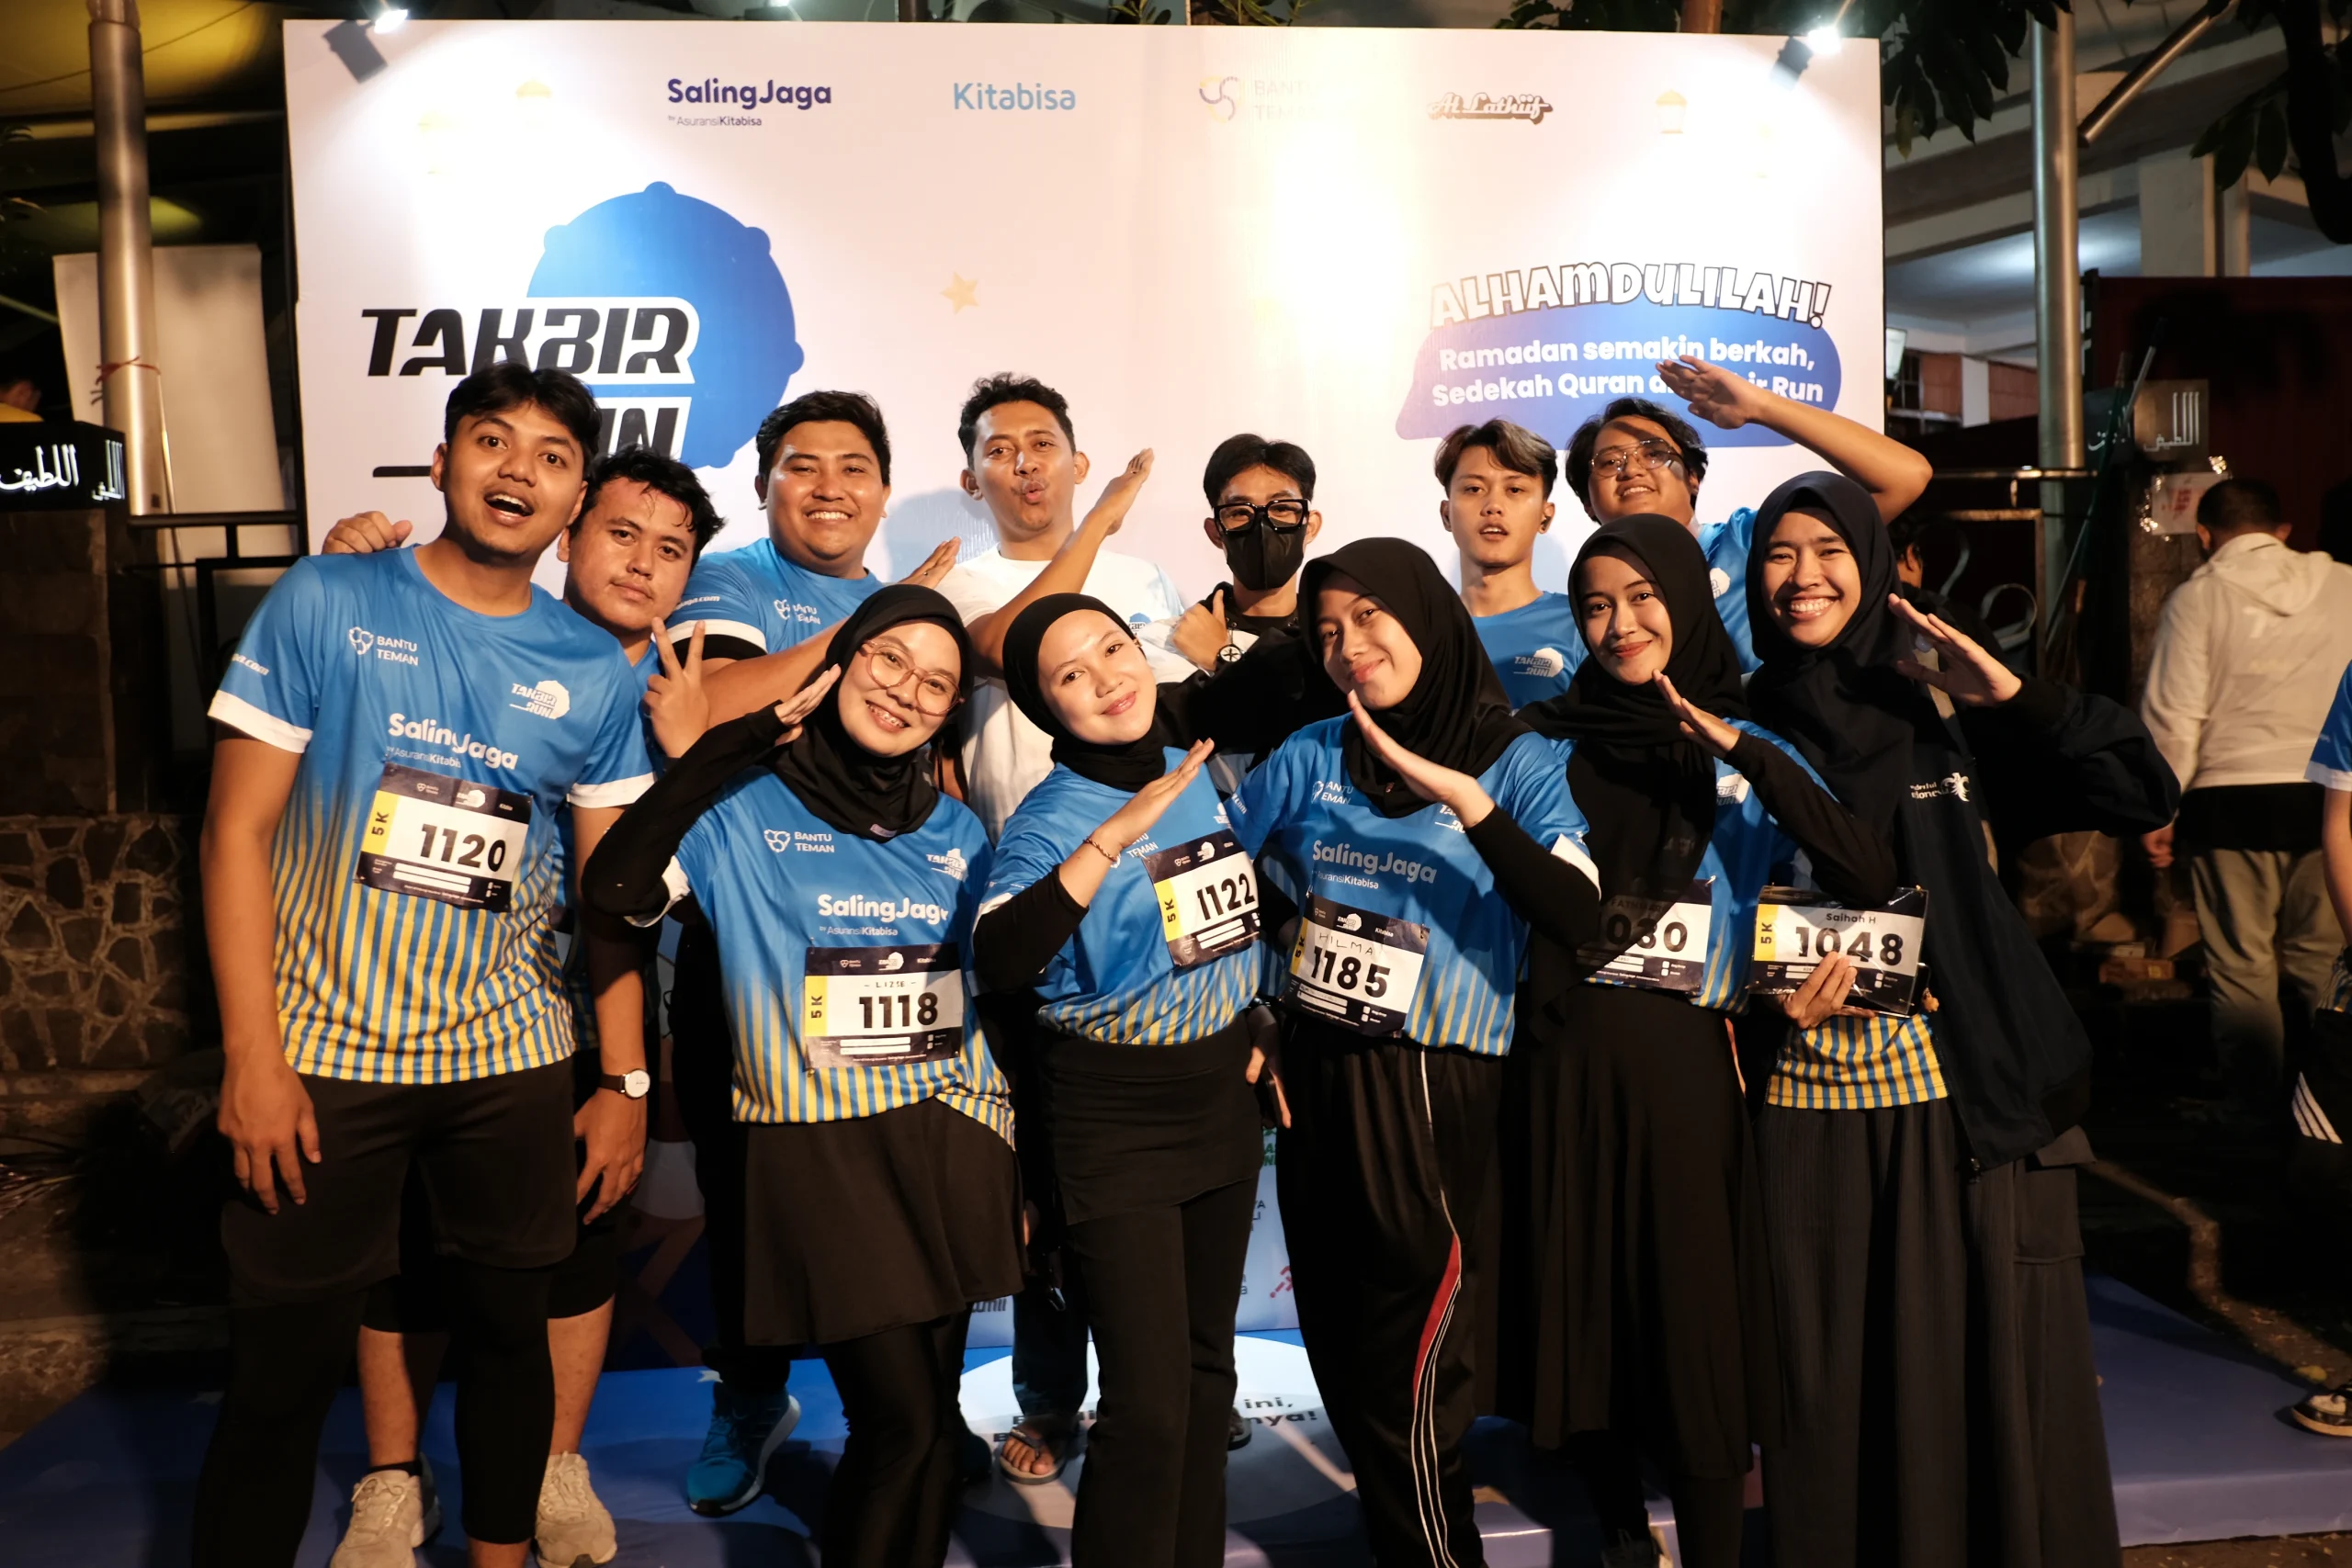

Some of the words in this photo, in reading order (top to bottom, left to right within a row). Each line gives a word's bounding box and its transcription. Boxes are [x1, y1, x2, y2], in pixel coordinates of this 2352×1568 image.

[667, 78, 831, 110] SalingJaga
[953, 83, 1077, 111] Kitabisa
[1254, 80, 1311, 96] BANT
[677, 117, 763, 127] AsuransiKitabisa
[1253, 105, 1312, 120] TEM
[1430, 261, 1832, 332] ALHAMDULILAH!
[361, 308, 689, 377] TAKBIR
[1439, 337, 1577, 371] Ramadan
[1583, 334, 1704, 361] semakin
[1709, 337, 1815, 371] berkah,
[1431, 372, 1553, 407] Sedekah
[1557, 371, 1642, 397] Quran
[1772, 376, 1824, 402] Run
[795, 613, 821, 625] EMAN
[377, 636, 418, 652] BANTU
[377, 649, 419, 667] TEMAN
[511, 682, 558, 706] TAKBIR
[1321, 792, 1351, 805] EMAN
[1325, 781, 1353, 794] ANTU
[420, 823, 506, 873] 1120
[795, 831, 832, 842] BANTU
[796, 843, 835, 853] TEMAN
[1313, 840, 1437, 884] SalingJaga
[1196, 873, 1255, 921] 1122
[1868, 916, 1876, 924] H
[1318, 932, 1374, 956] HILMA
[1795, 926, 1904, 966] 1048
[1311, 946, 1391, 998] 1185
[859, 992, 939, 1029] 1118
